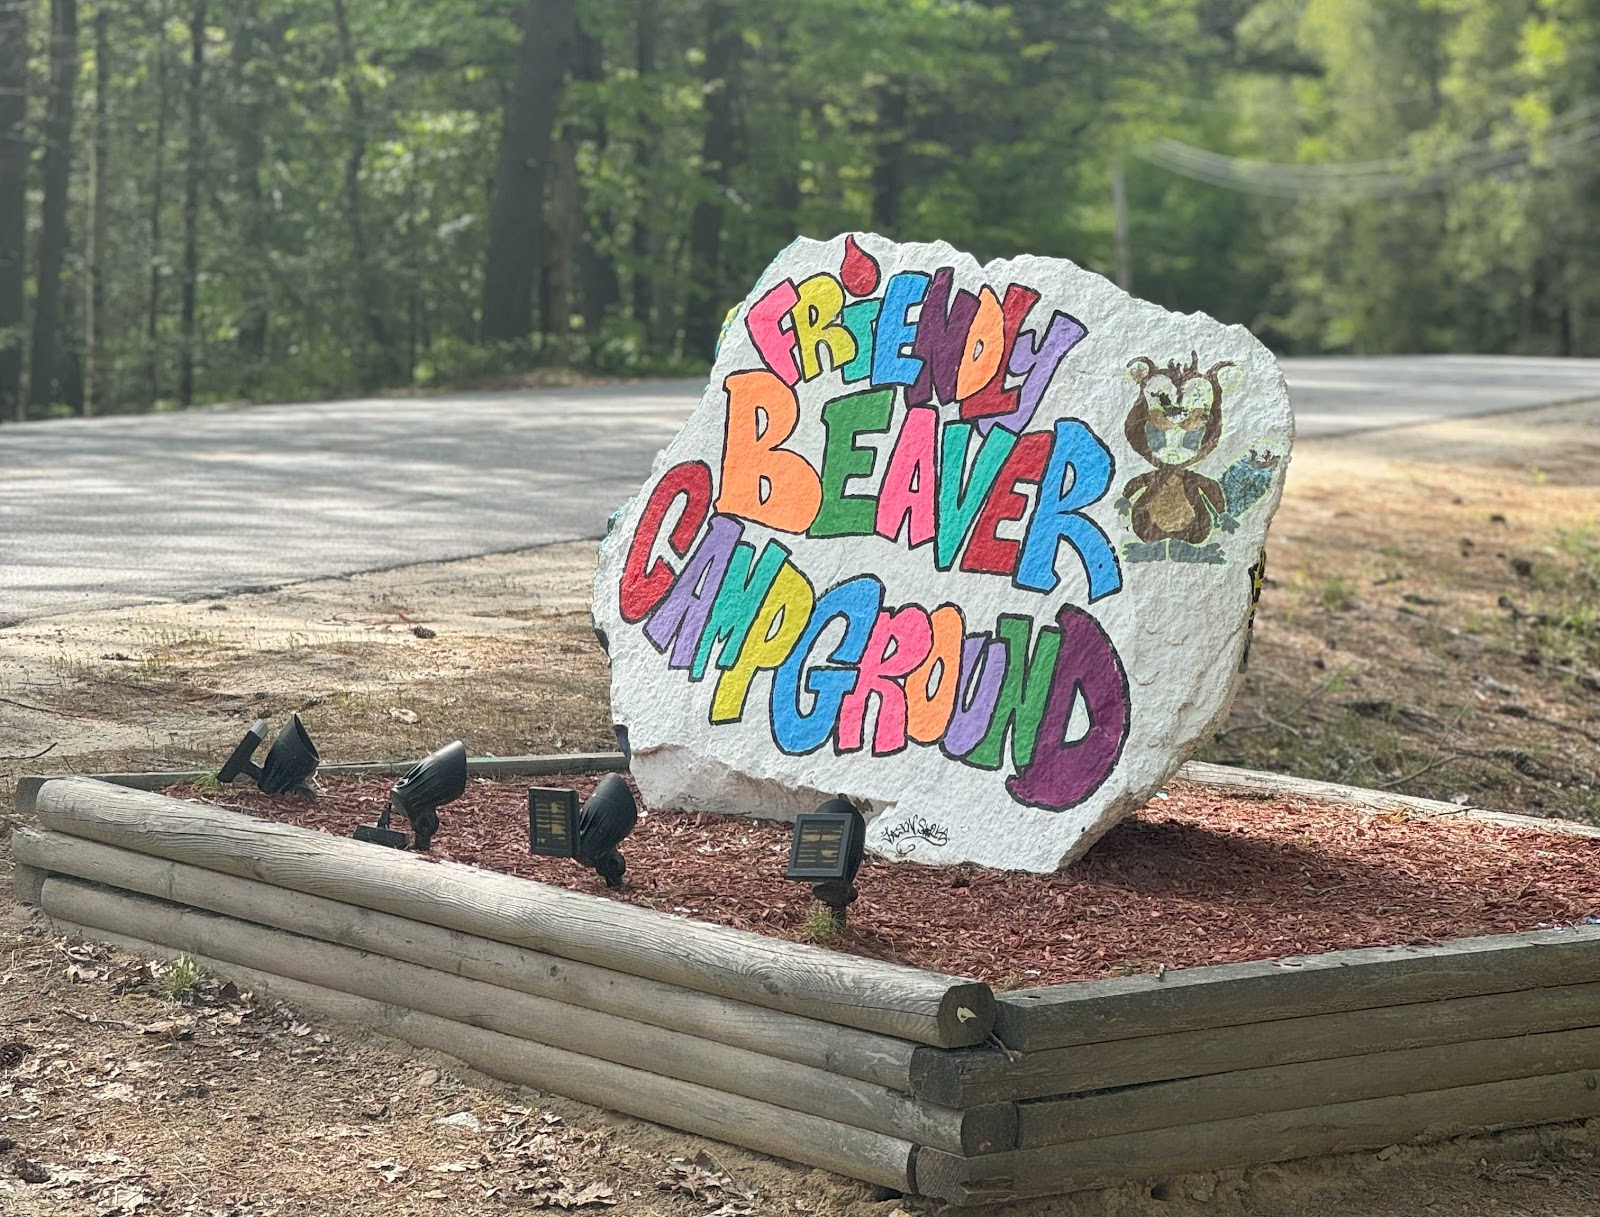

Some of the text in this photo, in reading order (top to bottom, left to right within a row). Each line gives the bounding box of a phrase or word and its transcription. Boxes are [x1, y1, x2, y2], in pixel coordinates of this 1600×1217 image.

[744, 234, 1089, 437] FRIENDLY
[715, 369, 1122, 603] BEAVER
[620, 460, 1130, 812] CAMPGROUND
